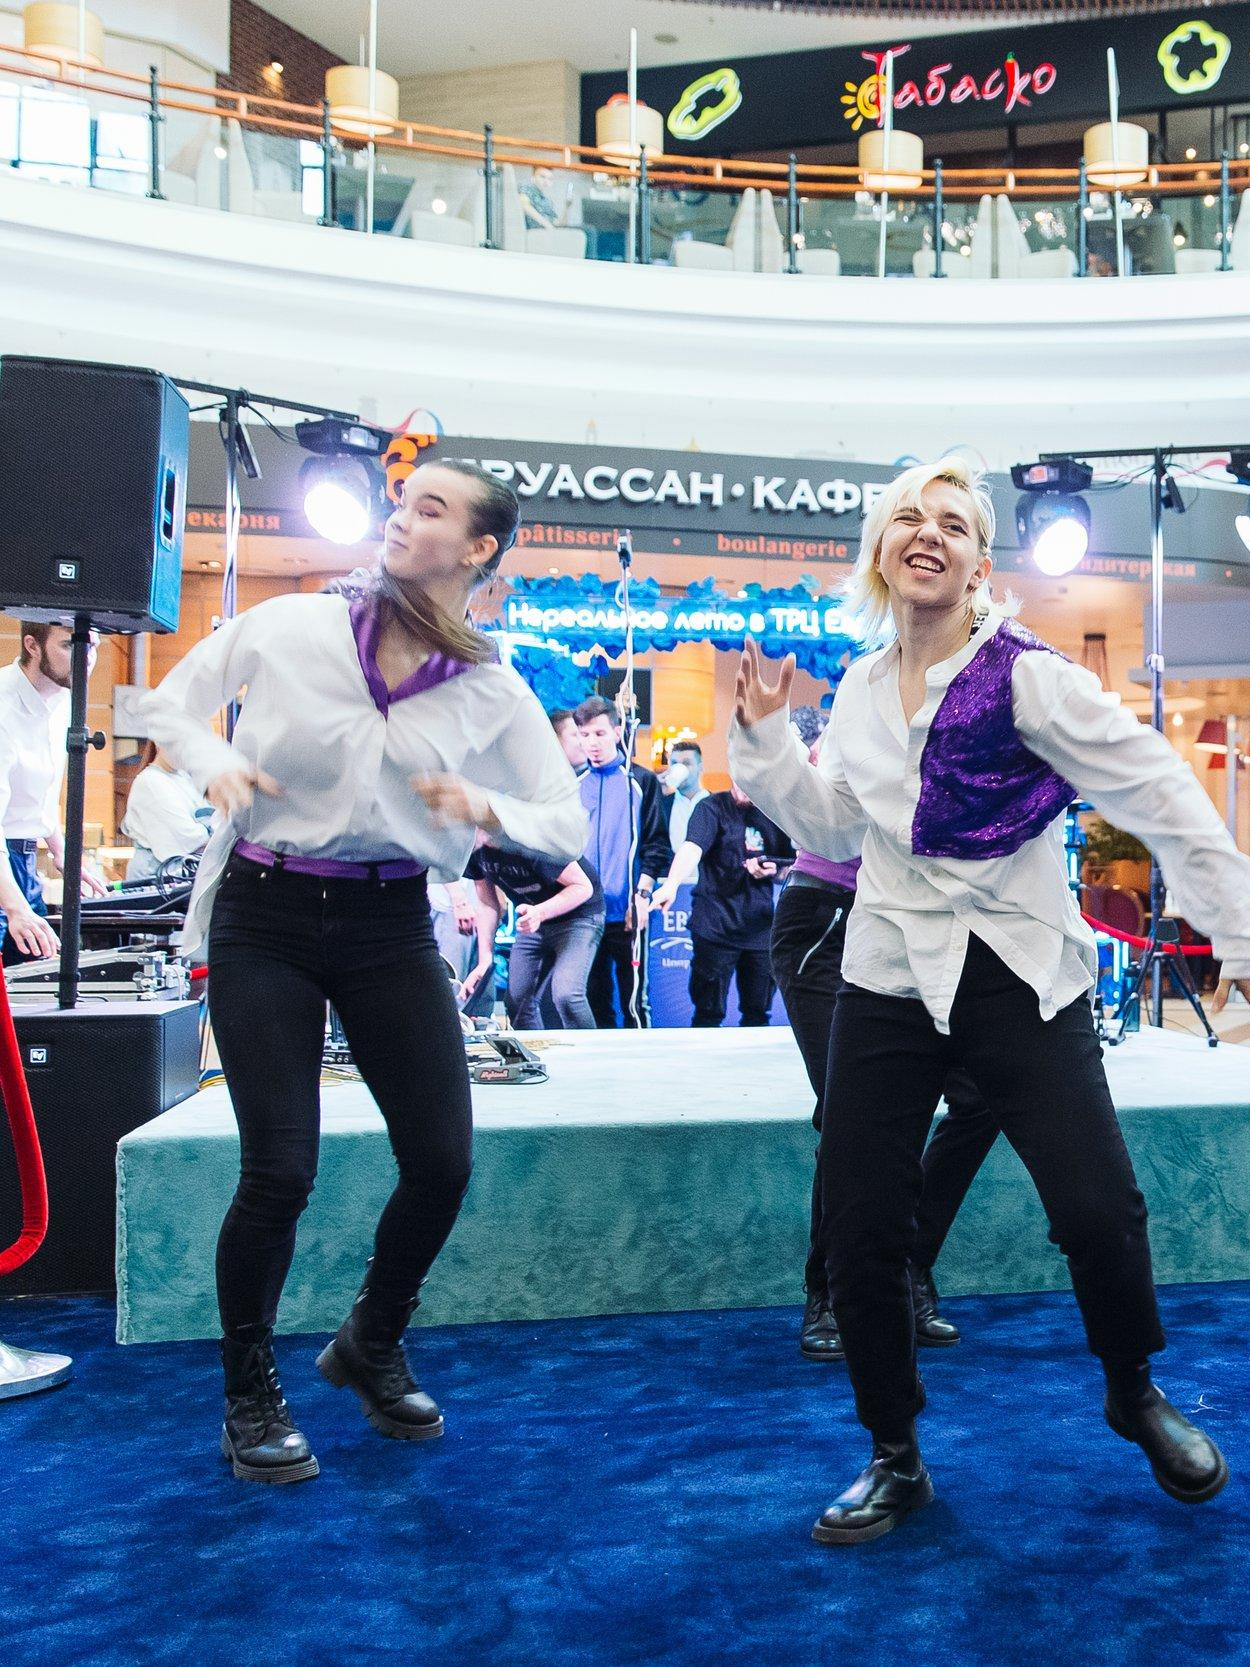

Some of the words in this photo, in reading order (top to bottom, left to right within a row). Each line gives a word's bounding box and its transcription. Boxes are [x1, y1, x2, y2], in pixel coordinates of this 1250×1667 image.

[860, 44, 1057, 127] Табаско
[441, 457, 725, 508] РУАССАН
[717, 533, 847, 560] boulangerie
[674, 613, 746, 632] лето
[749, 612, 766, 633] в
[770, 606, 821, 638] ТРЦ
